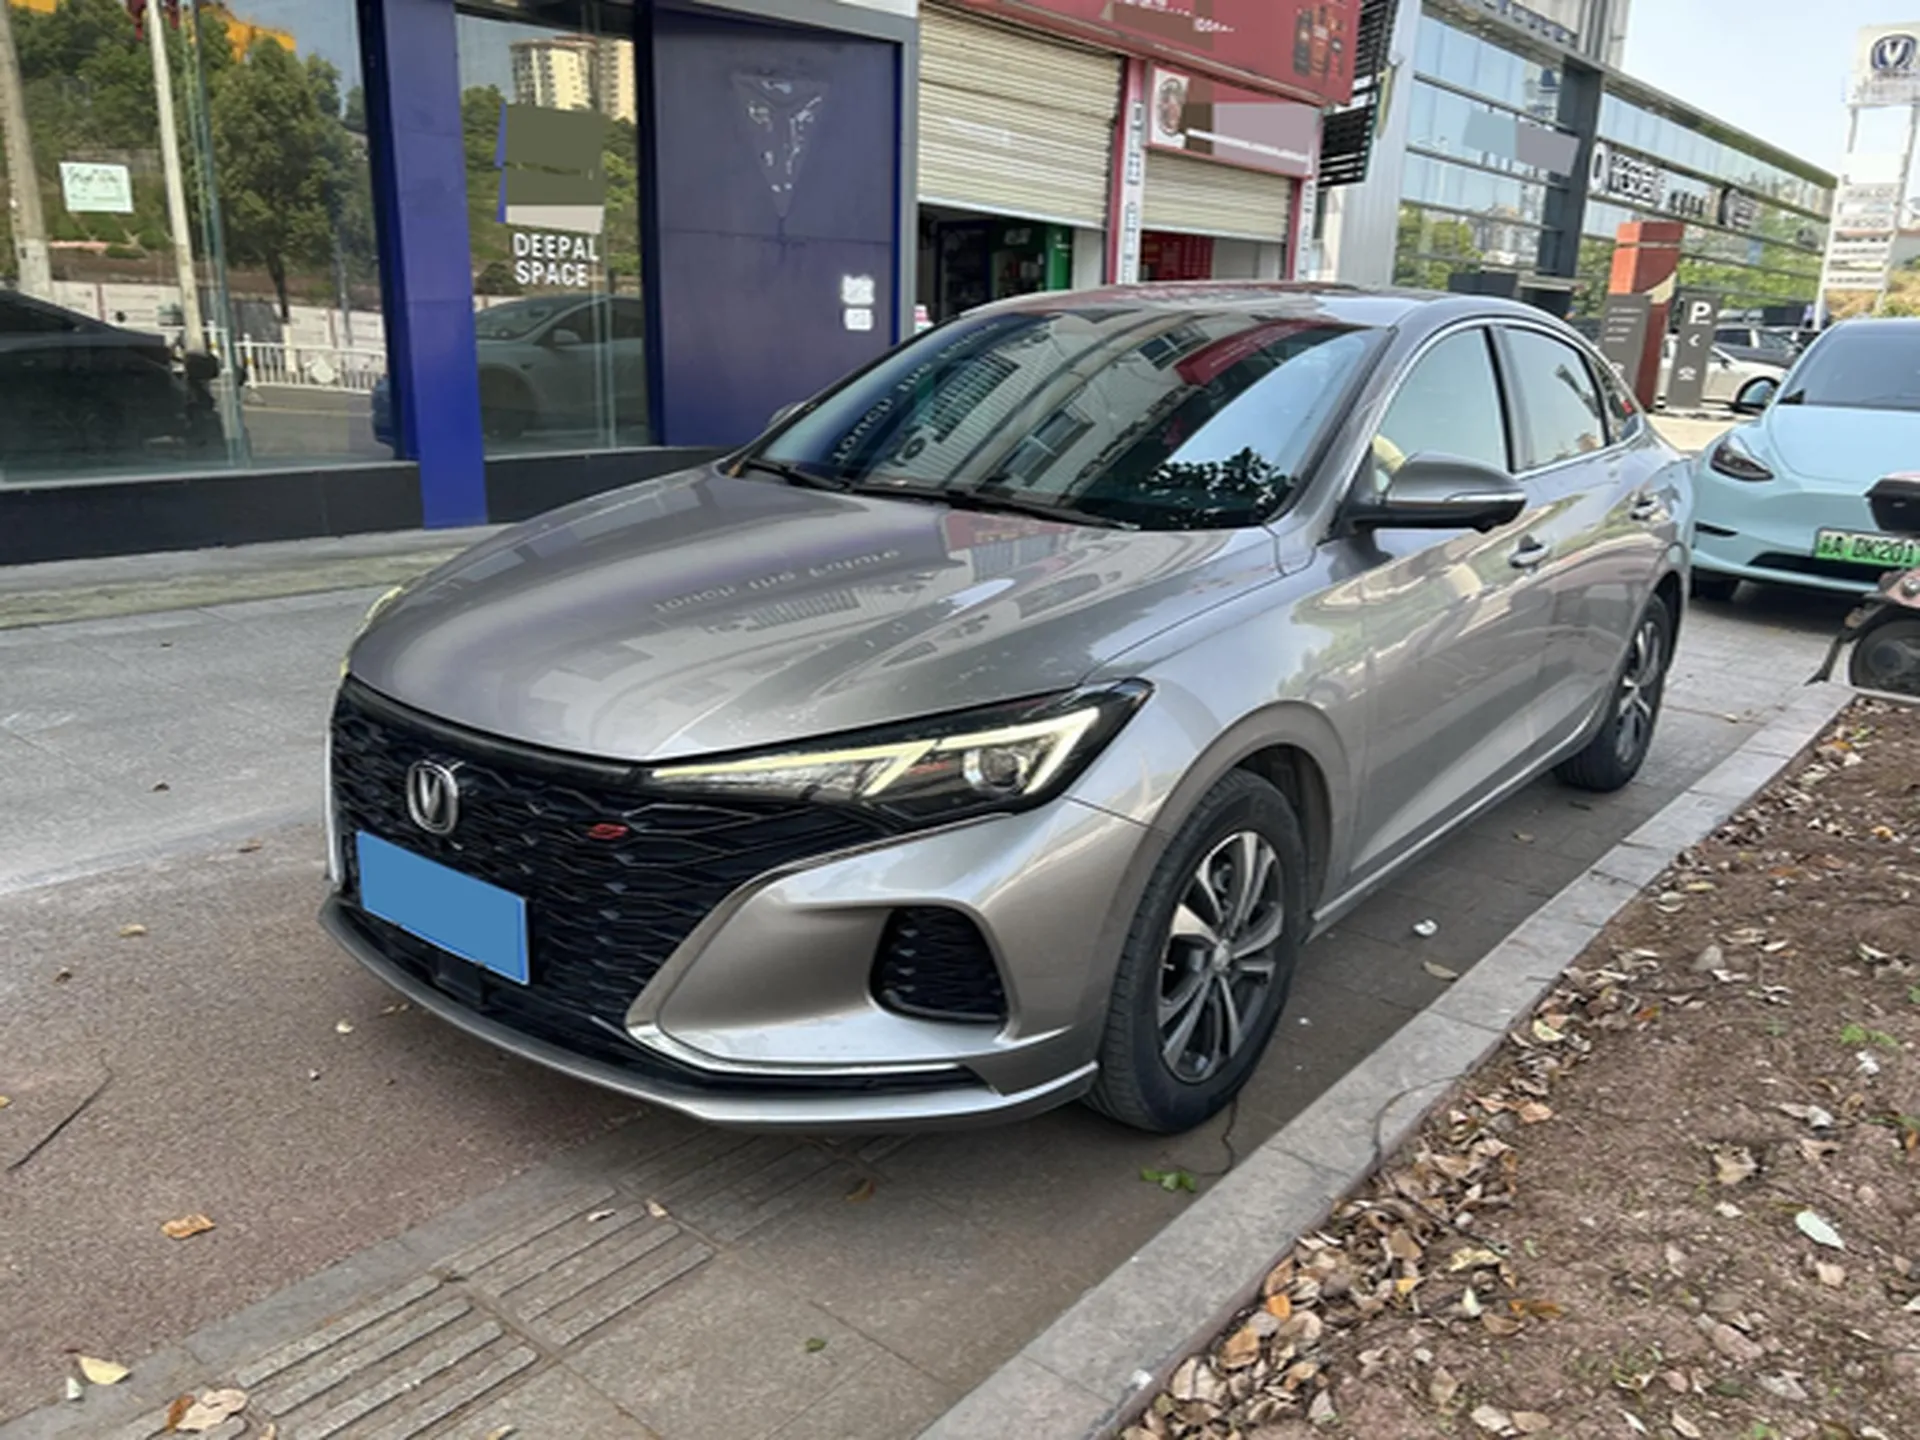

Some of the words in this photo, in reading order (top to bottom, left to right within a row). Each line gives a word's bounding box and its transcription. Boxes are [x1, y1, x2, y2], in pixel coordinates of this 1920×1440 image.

[513, 233, 599, 262] DEEPAL
[515, 260, 588, 287] SPACE
[1689, 301, 1711, 324] P
